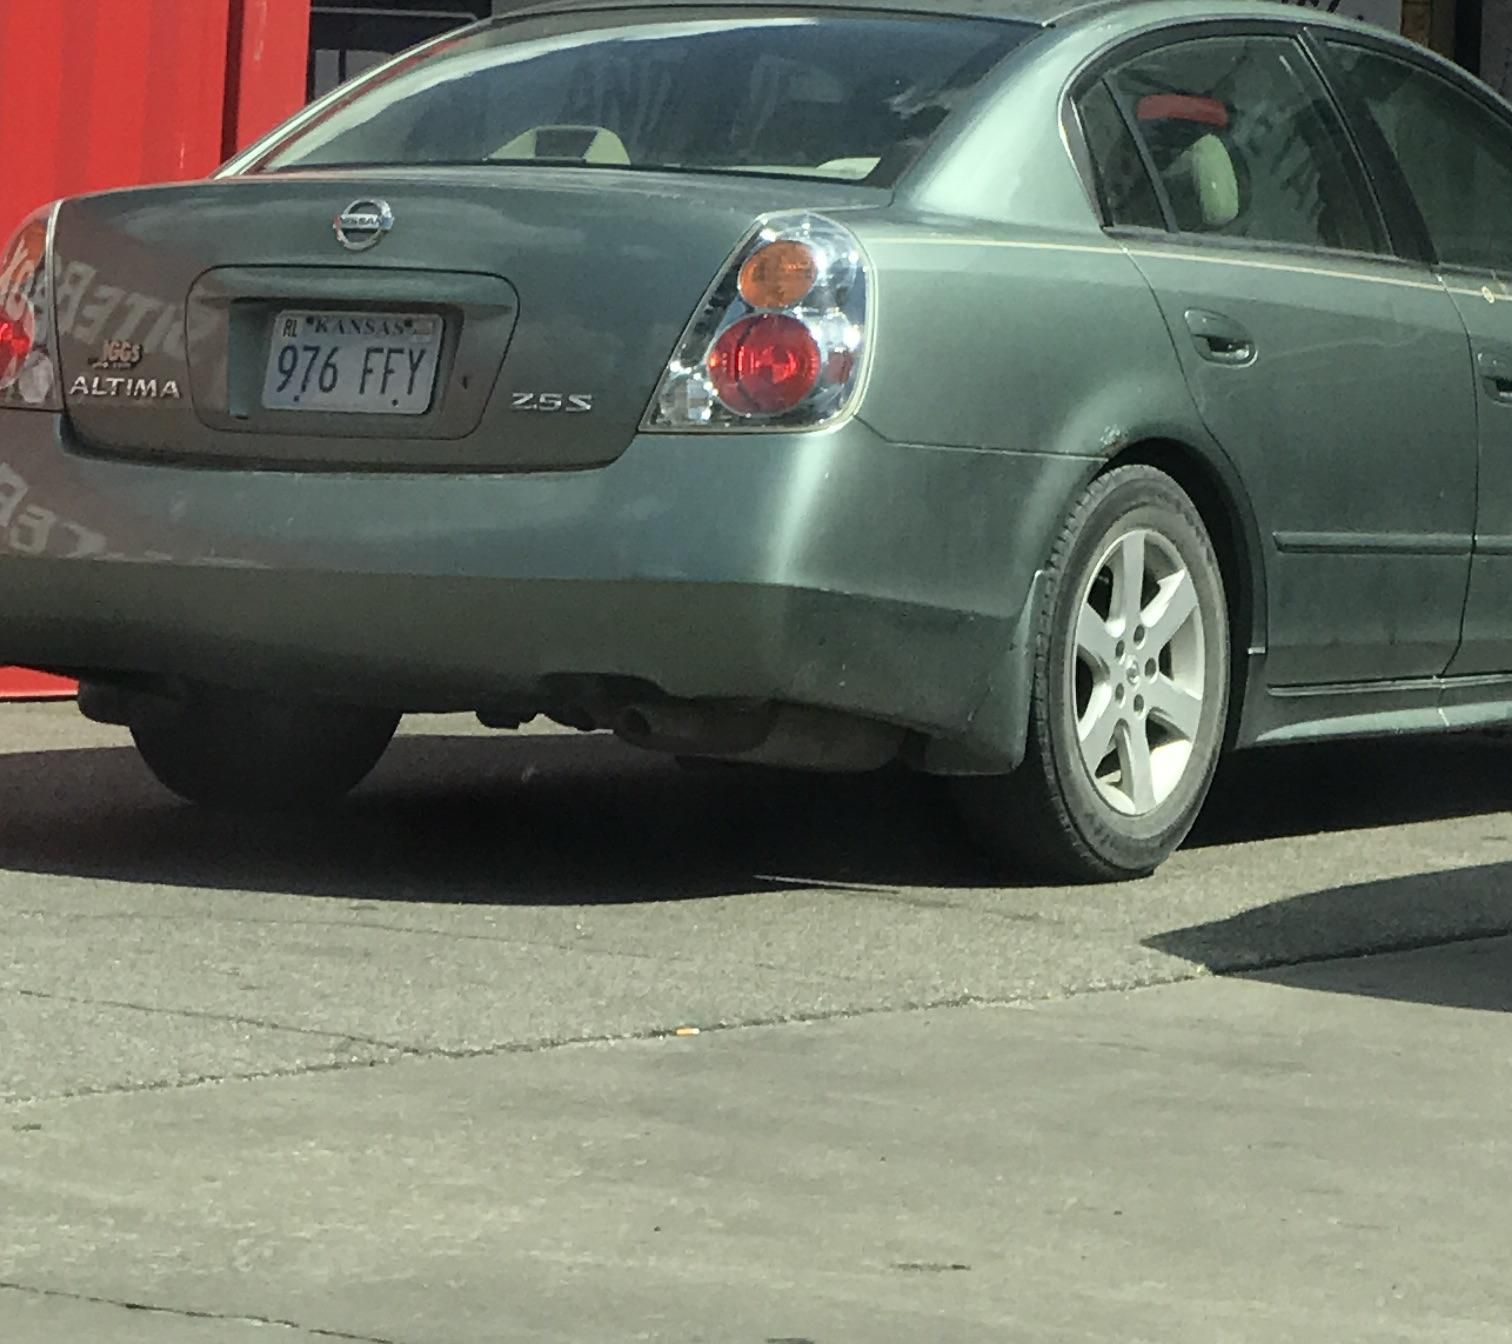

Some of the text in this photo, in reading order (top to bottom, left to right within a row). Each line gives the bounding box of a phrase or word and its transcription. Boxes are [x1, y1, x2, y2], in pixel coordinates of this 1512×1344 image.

[314, 318, 405, 335] KANSAS
[276, 344, 427, 396] 976 FFY
[69, 375, 181, 400] ALTIMA
